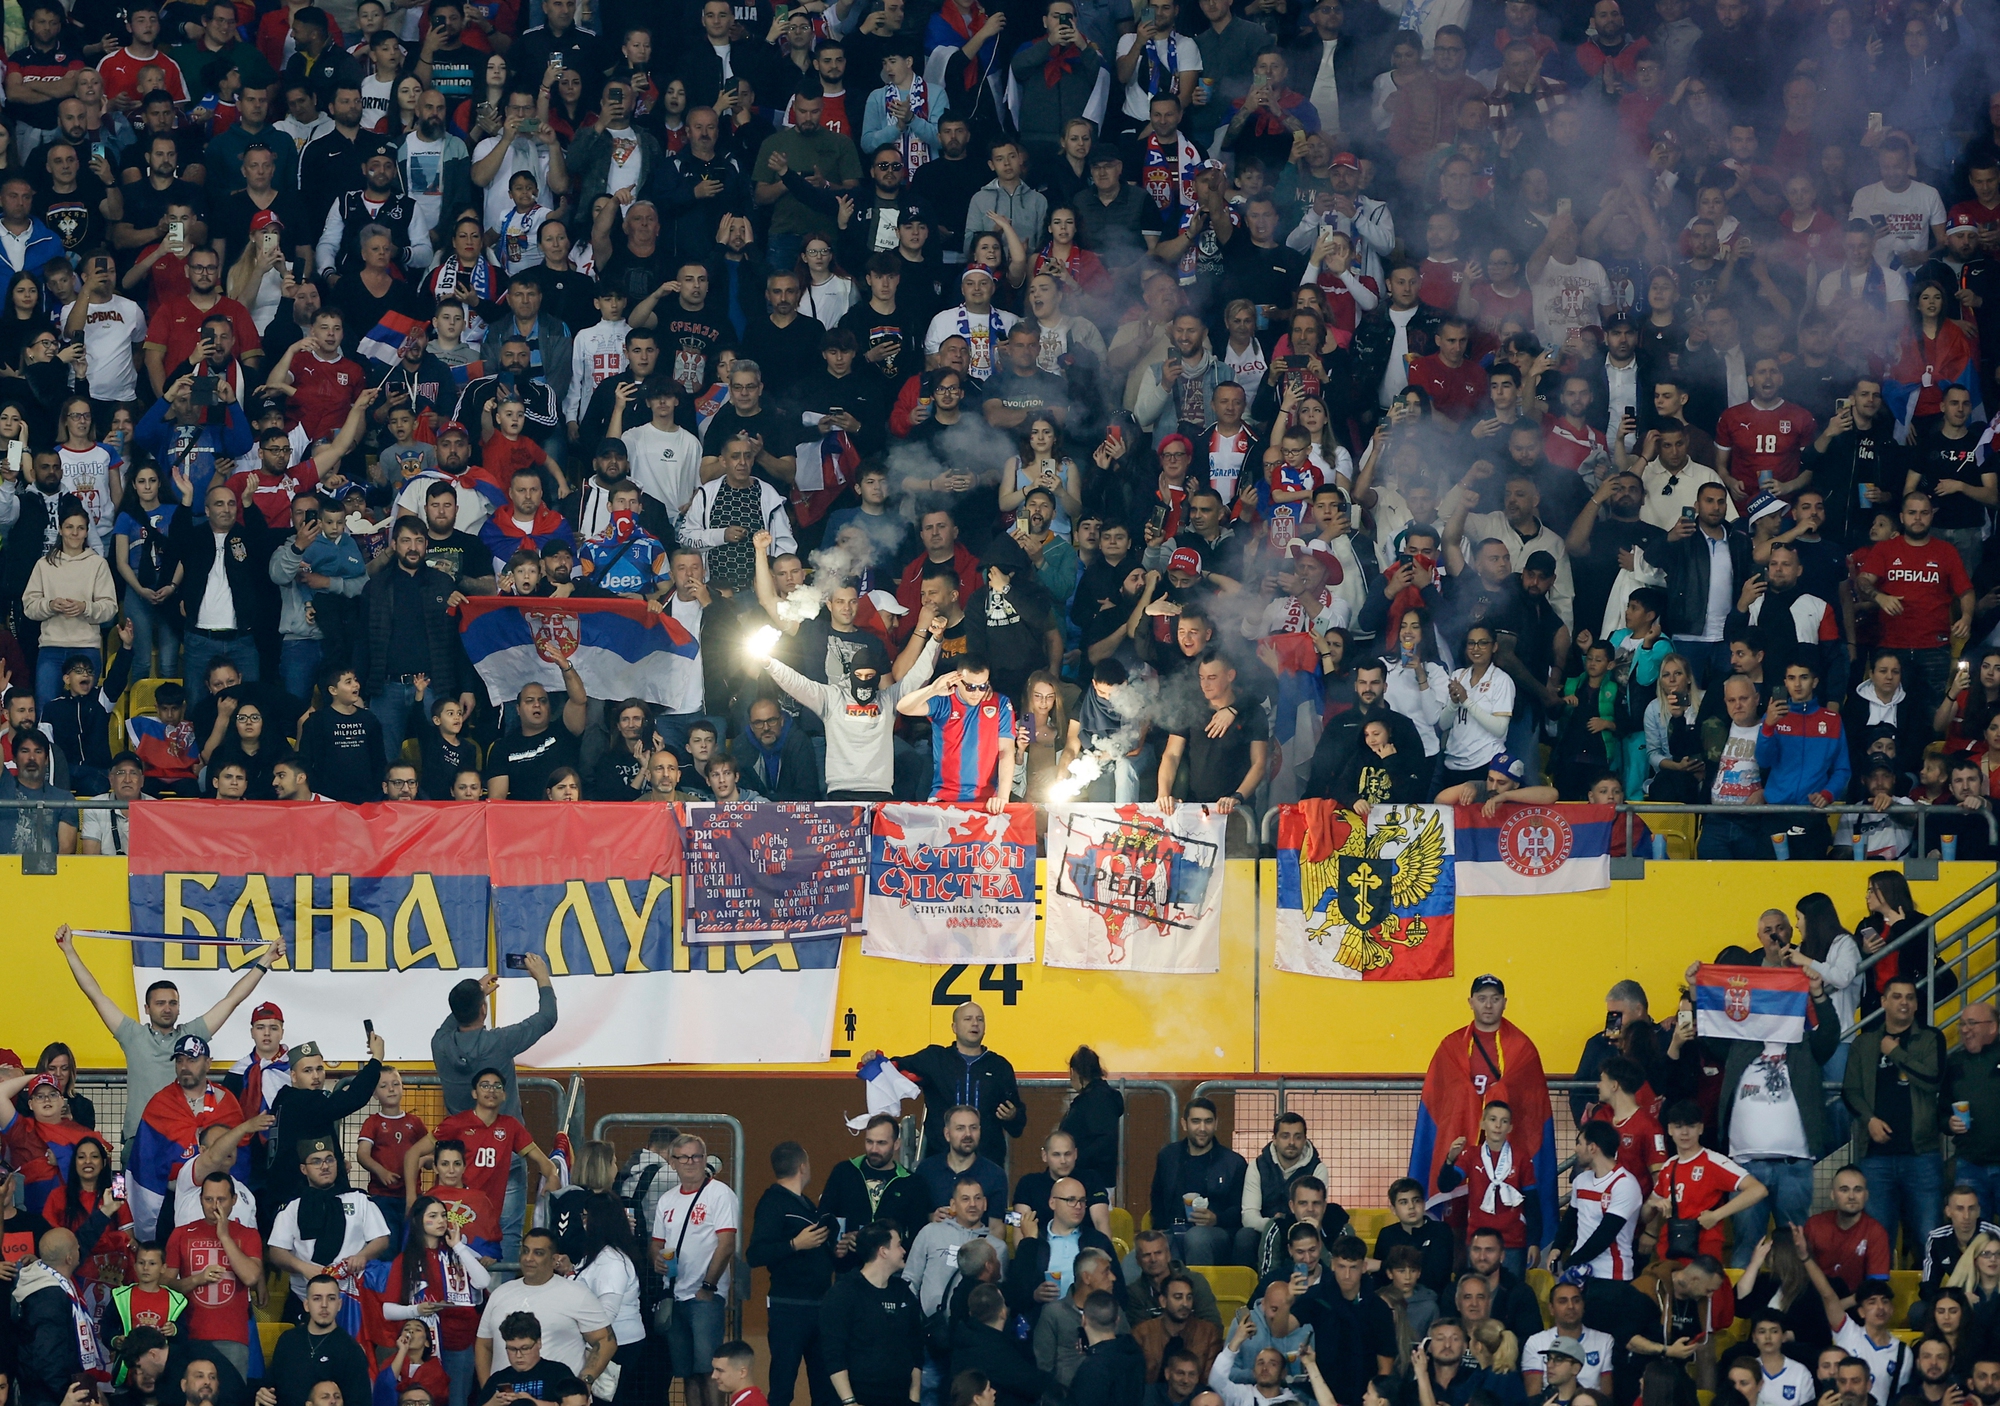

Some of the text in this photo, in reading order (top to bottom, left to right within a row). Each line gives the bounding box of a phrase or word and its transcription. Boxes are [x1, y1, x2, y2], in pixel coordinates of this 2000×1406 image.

[86, 311, 125, 324] СРБИЈА
[670, 321, 720, 341] СРБИЈА
[1755, 434, 1777, 454] 18
[600, 572, 642, 589] Jeep
[1887, 568, 1940, 584] СРБИЈА
[1457, 706, 1468, 725] 14
[335, 722, 363, 730] TOMMY
[1101, 830, 1174, 865] НЕМА
[878, 867, 1024, 909] СРПСТВА
[914, 904, 975, 917] ЕПУБЛИКА
[162, 871, 459, 972] БАЊА
[931, 963, 1023, 1006] 24
[1474, 1074, 1488, 1095] 9
[394, 1131, 403, 1144] 9
[475, 1147, 496, 1168] 08
